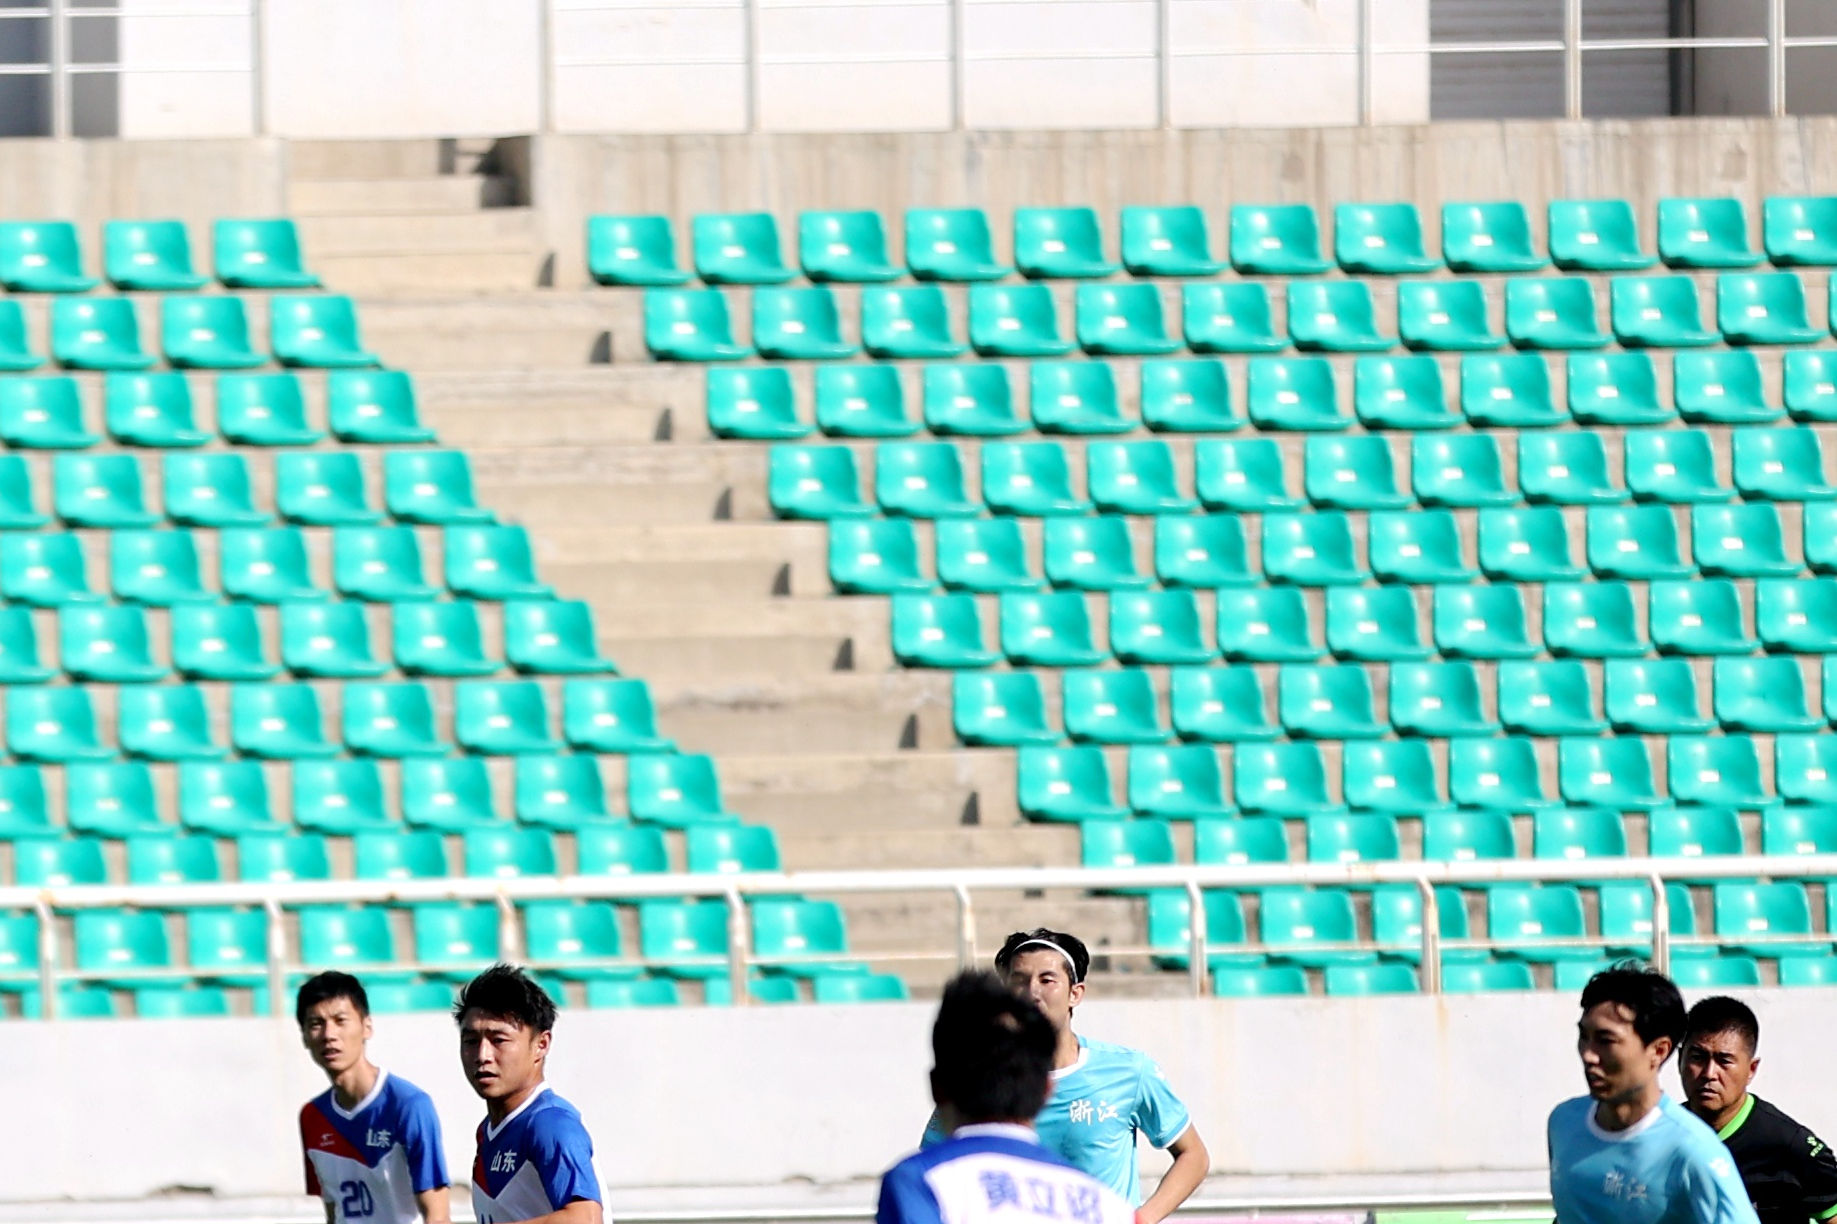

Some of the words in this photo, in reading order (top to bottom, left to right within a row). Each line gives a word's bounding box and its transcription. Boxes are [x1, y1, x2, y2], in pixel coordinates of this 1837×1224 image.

[1069, 1100, 1118, 1126] 浙江
[366, 1129, 392, 1149] 山东
[490, 1150, 517, 1173] 山东
[340, 1180, 375, 1219] 20
